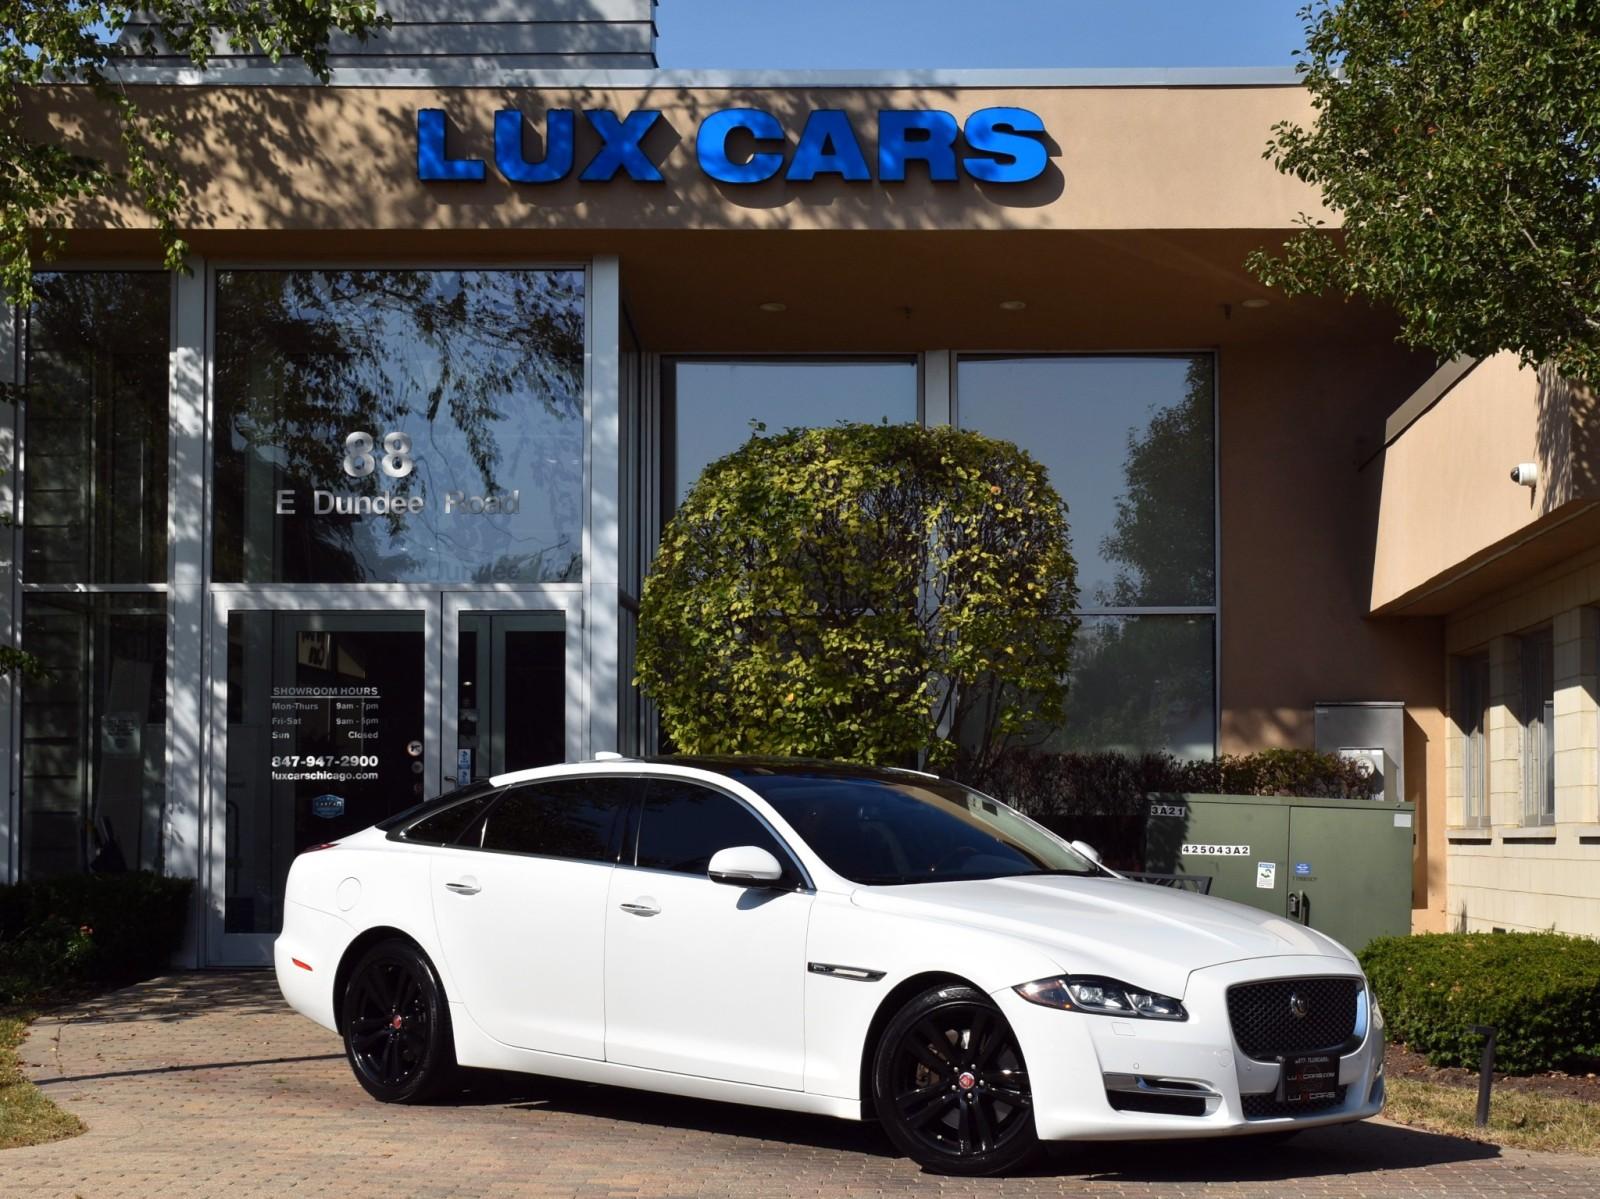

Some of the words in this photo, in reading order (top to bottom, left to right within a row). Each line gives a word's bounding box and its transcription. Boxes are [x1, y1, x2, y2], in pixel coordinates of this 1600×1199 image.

[417, 108, 665, 184] LUX
[697, 106, 1049, 184] CARS
[343, 431, 413, 478] 88
[276, 490, 296, 515] E
[314, 490, 424, 515] Dundee
[444, 490, 520, 515] Road
[273, 687, 338, 696] SHOWROOM
[340, 687, 379, 695] HOURS
[271, 702, 319, 711] Mon-Thurs
[336, 702, 354, 710] 9am
[271, 717, 302, 726] Fri-Sat
[271, 731, 290, 740] Sun
[347, 731, 379, 740] Closed
[271, 755, 379, 767] 847-947-2900
[271, 771, 379, 782] luxcarschicago.com
[1151, 806, 1185, 816] 3A21
[1183, 845, 1249, 855] 425043A2
